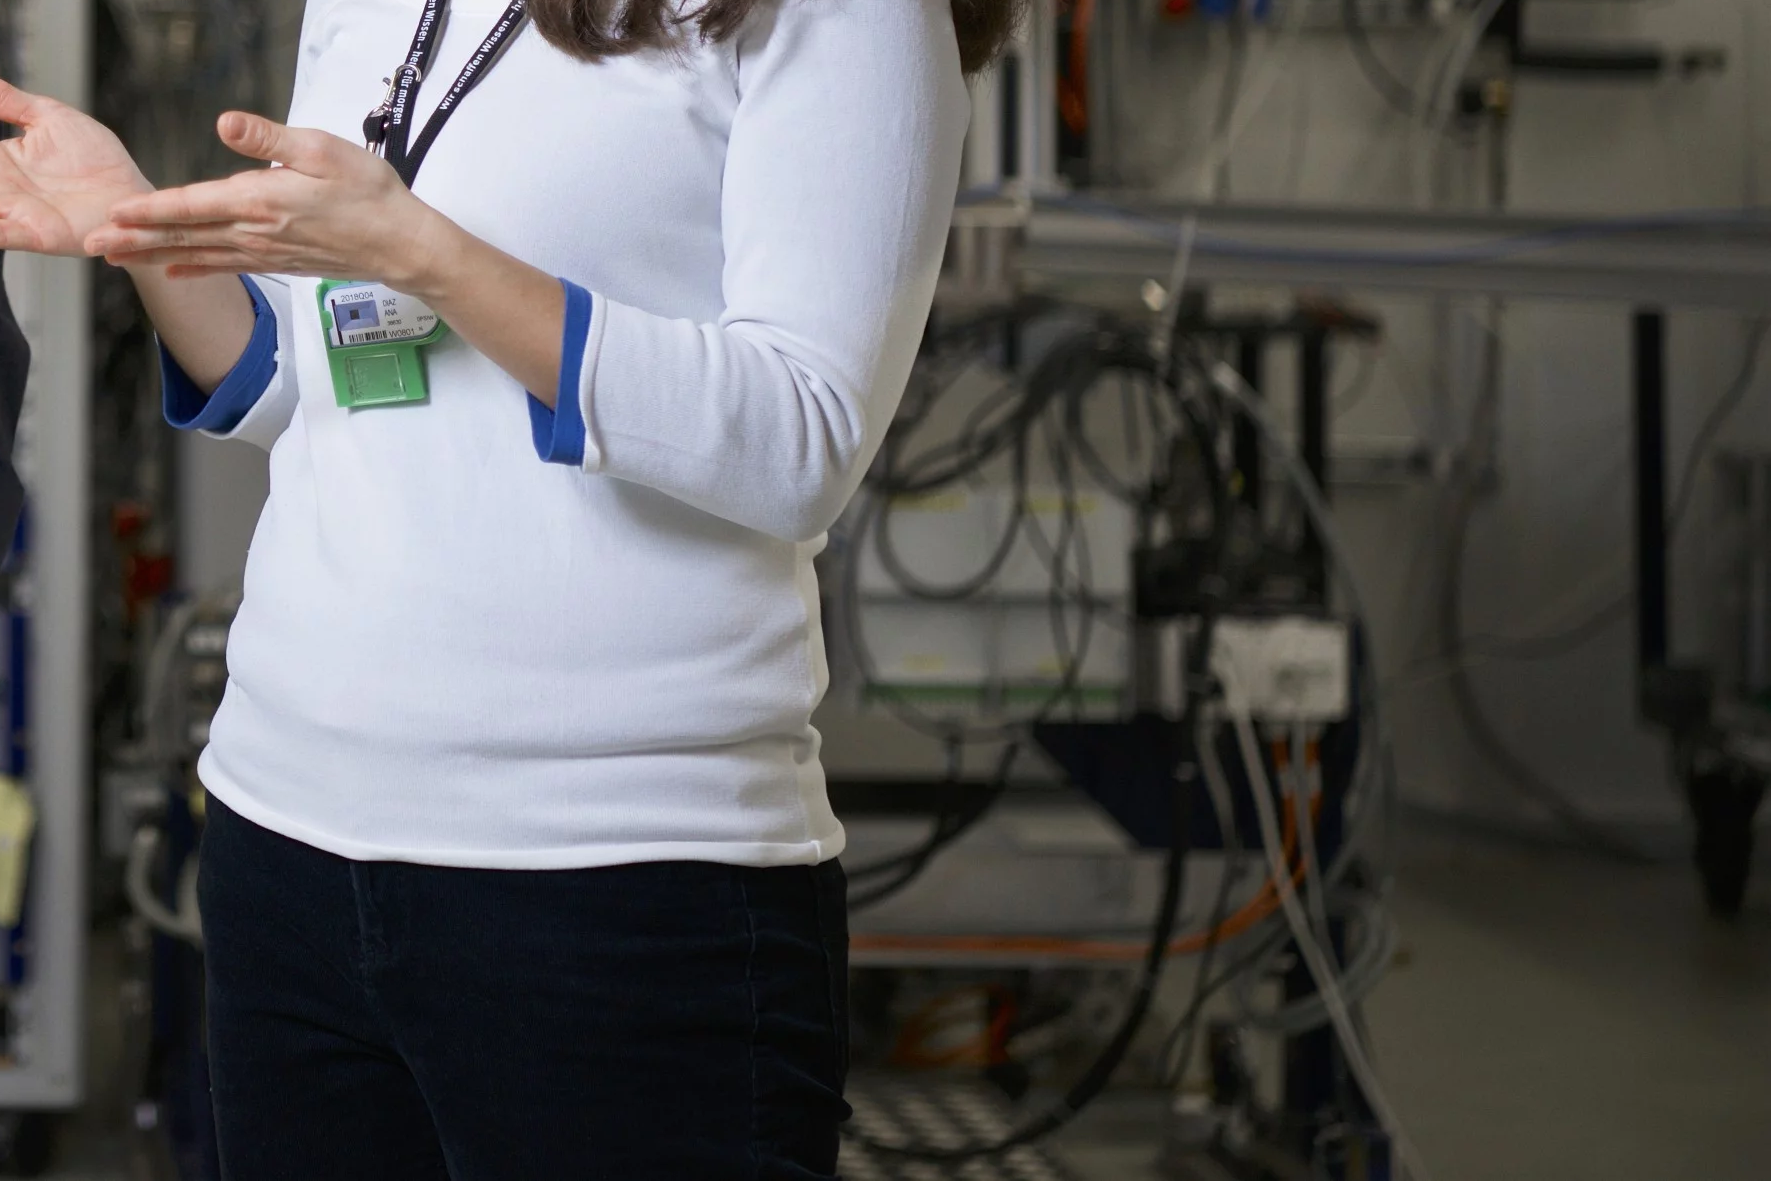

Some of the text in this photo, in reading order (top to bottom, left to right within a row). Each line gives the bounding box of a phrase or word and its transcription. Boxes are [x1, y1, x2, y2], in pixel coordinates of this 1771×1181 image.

[417, 10, 436, 41] Wissen
[404, 51, 423, 75] heue
[439, 93, 455, 110] Wir
[453, 53, 485, 93] schaffen
[480, 20, 510, 53] Wissen
[401, 75, 413, 87] für
[393, 89, 407, 124] morgen
[340, 291, 374, 302] 2018Q04
[382, 299, 396, 307] DIAZ
[384, 309, 397, 317] ANA
